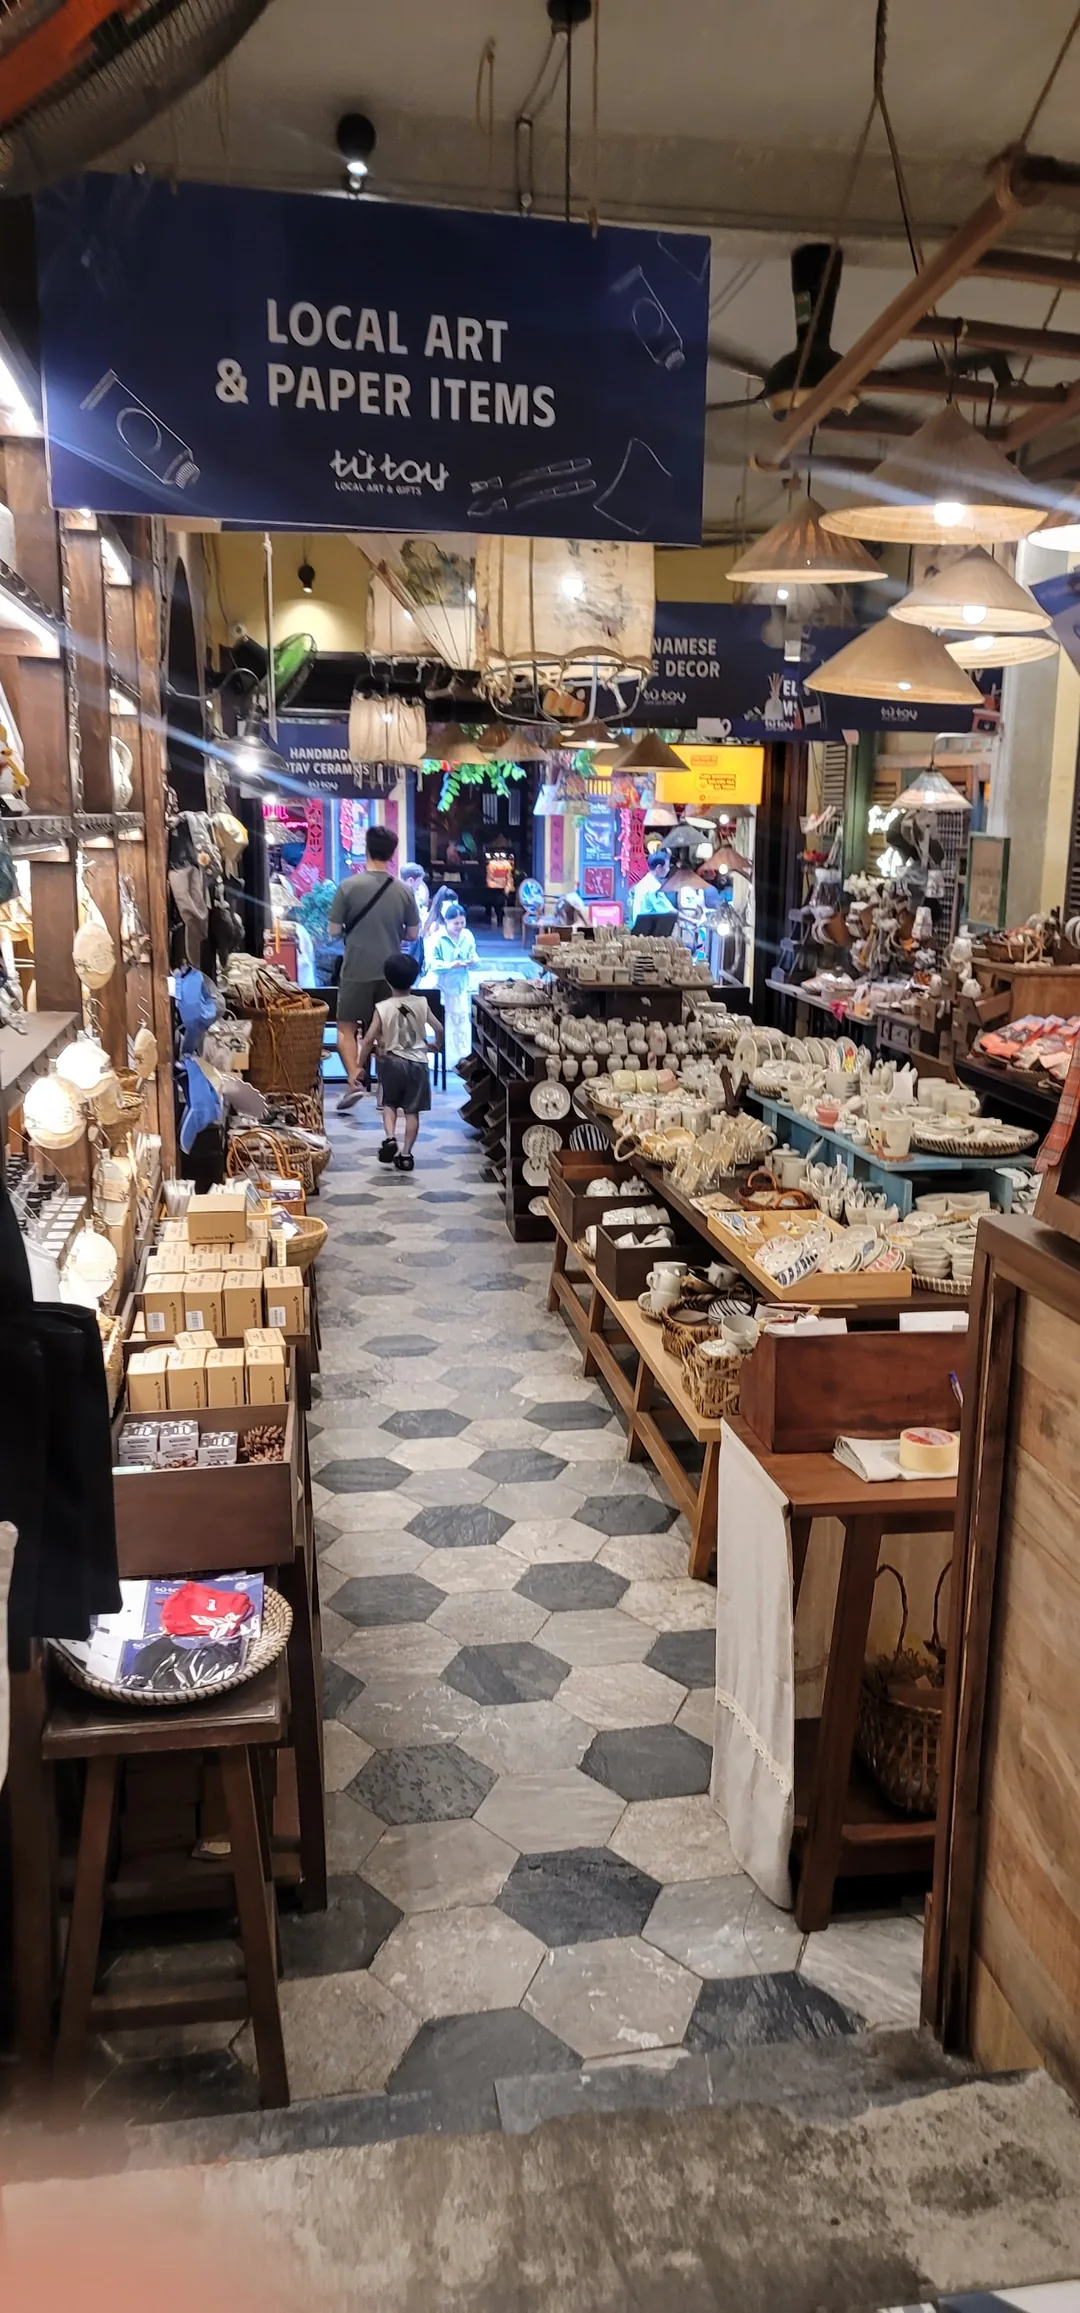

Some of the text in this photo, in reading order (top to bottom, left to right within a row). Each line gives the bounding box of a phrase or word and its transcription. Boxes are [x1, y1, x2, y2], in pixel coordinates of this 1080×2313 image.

[267, 298, 509, 363] LOCAL ART
[215, 358, 556, 428] & PAPER ITEMS
[334, 480, 365, 493] LOCAL
[366, 482, 384, 494] ART
[395, 485, 422, 497] GIFTS
[665, 659, 721, 678] DECOR
[313, 761, 371, 776] CERAMS
